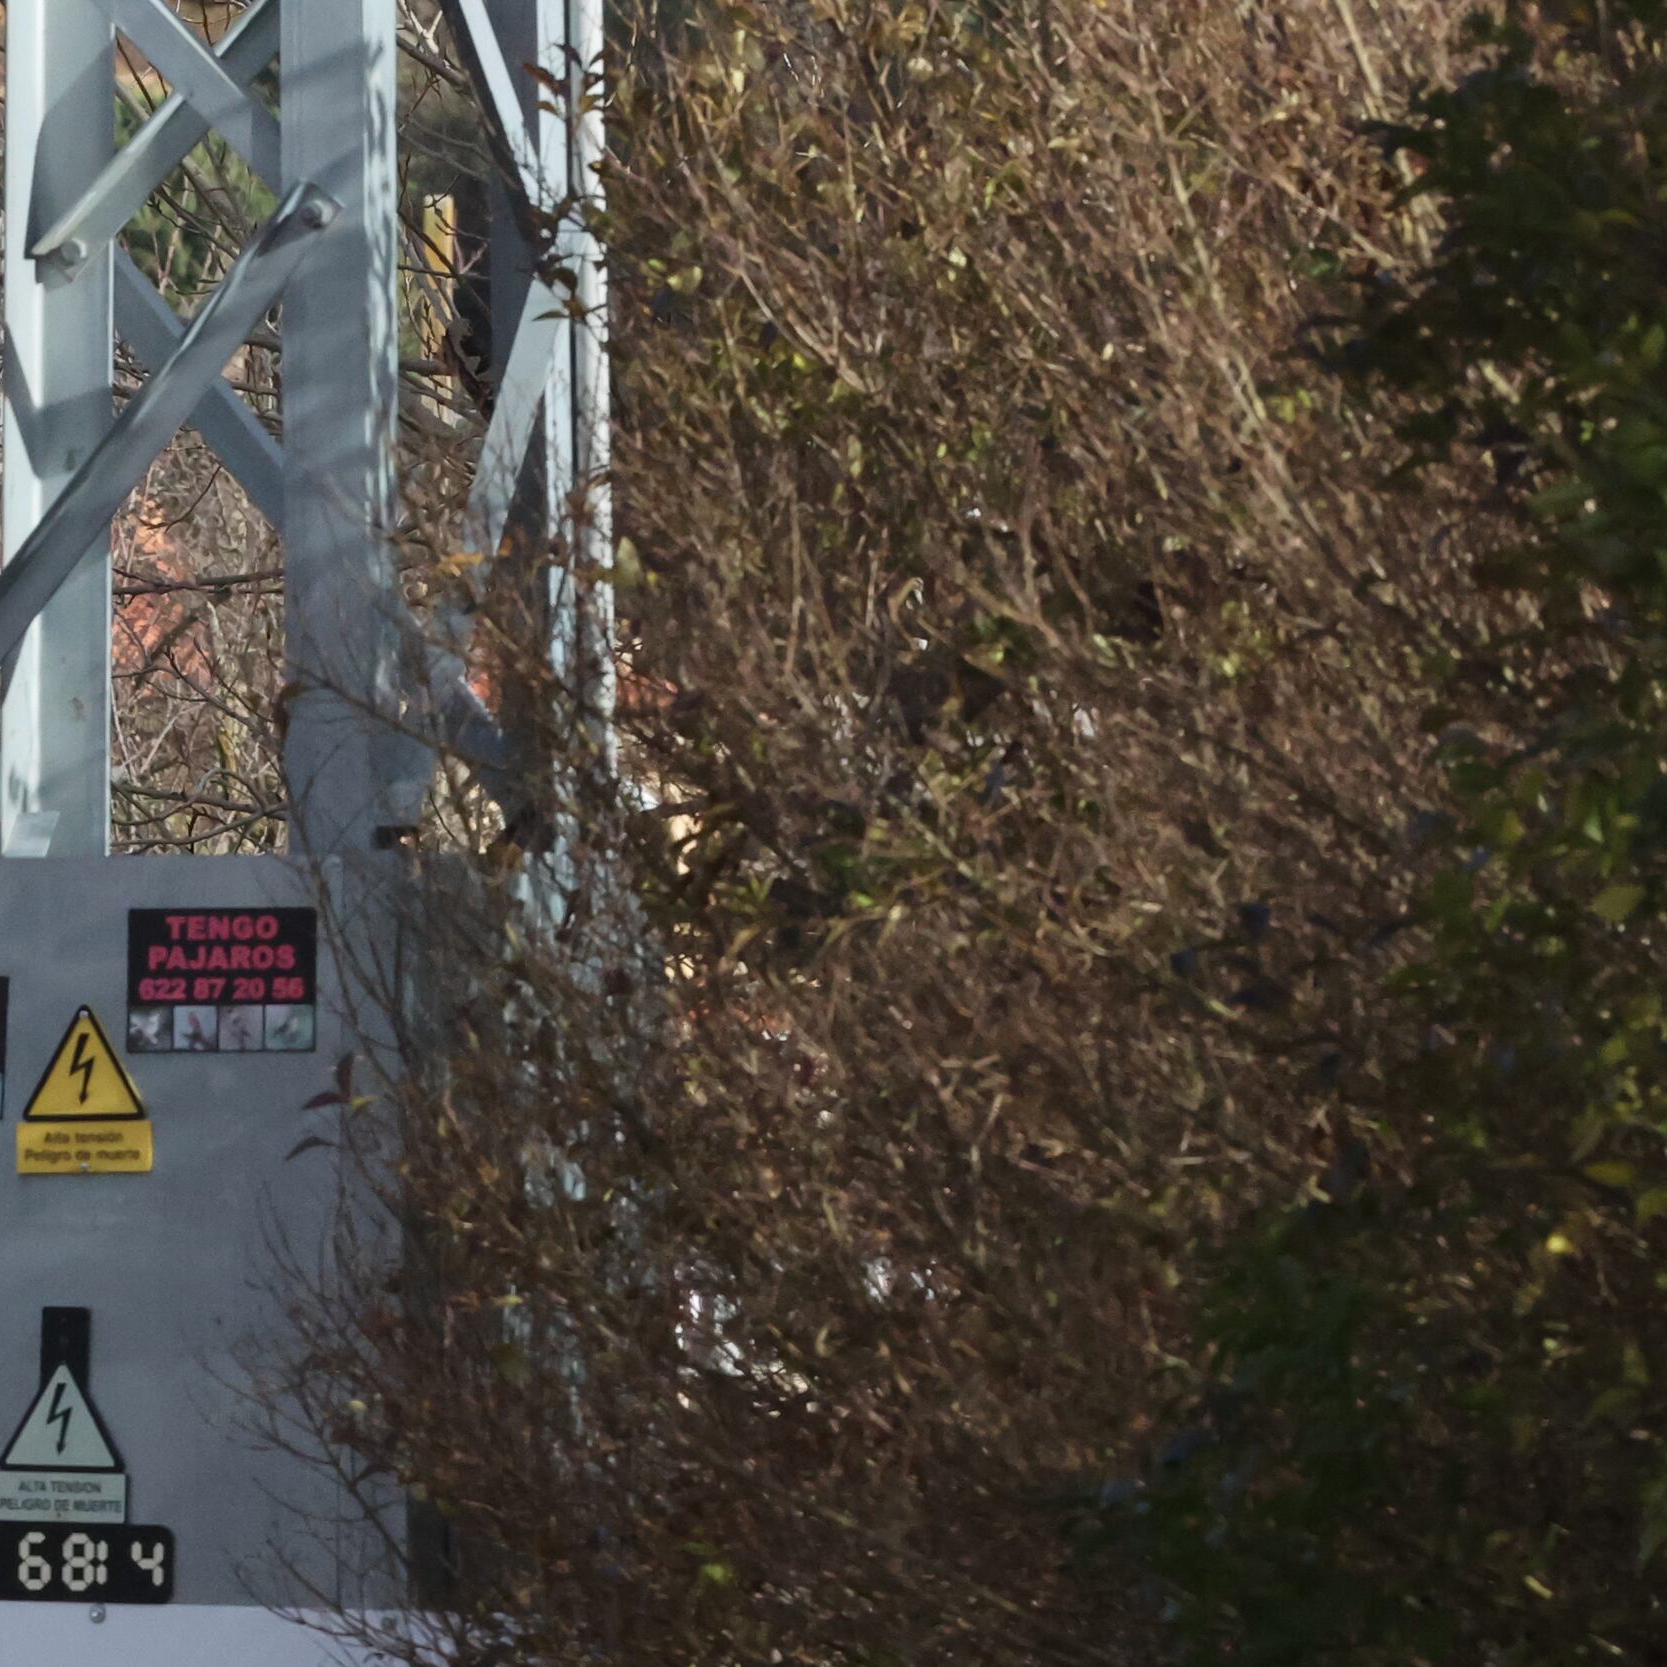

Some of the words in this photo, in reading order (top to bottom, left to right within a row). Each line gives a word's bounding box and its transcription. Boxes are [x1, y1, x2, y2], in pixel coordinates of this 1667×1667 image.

[166, 914, 279, 941] TENGO
[148, 944, 296, 971] PAJAROS
[139, 977, 187, 1000] 622
[193, 977, 226, 999] 87
[233, 977, 265, 999] 20
